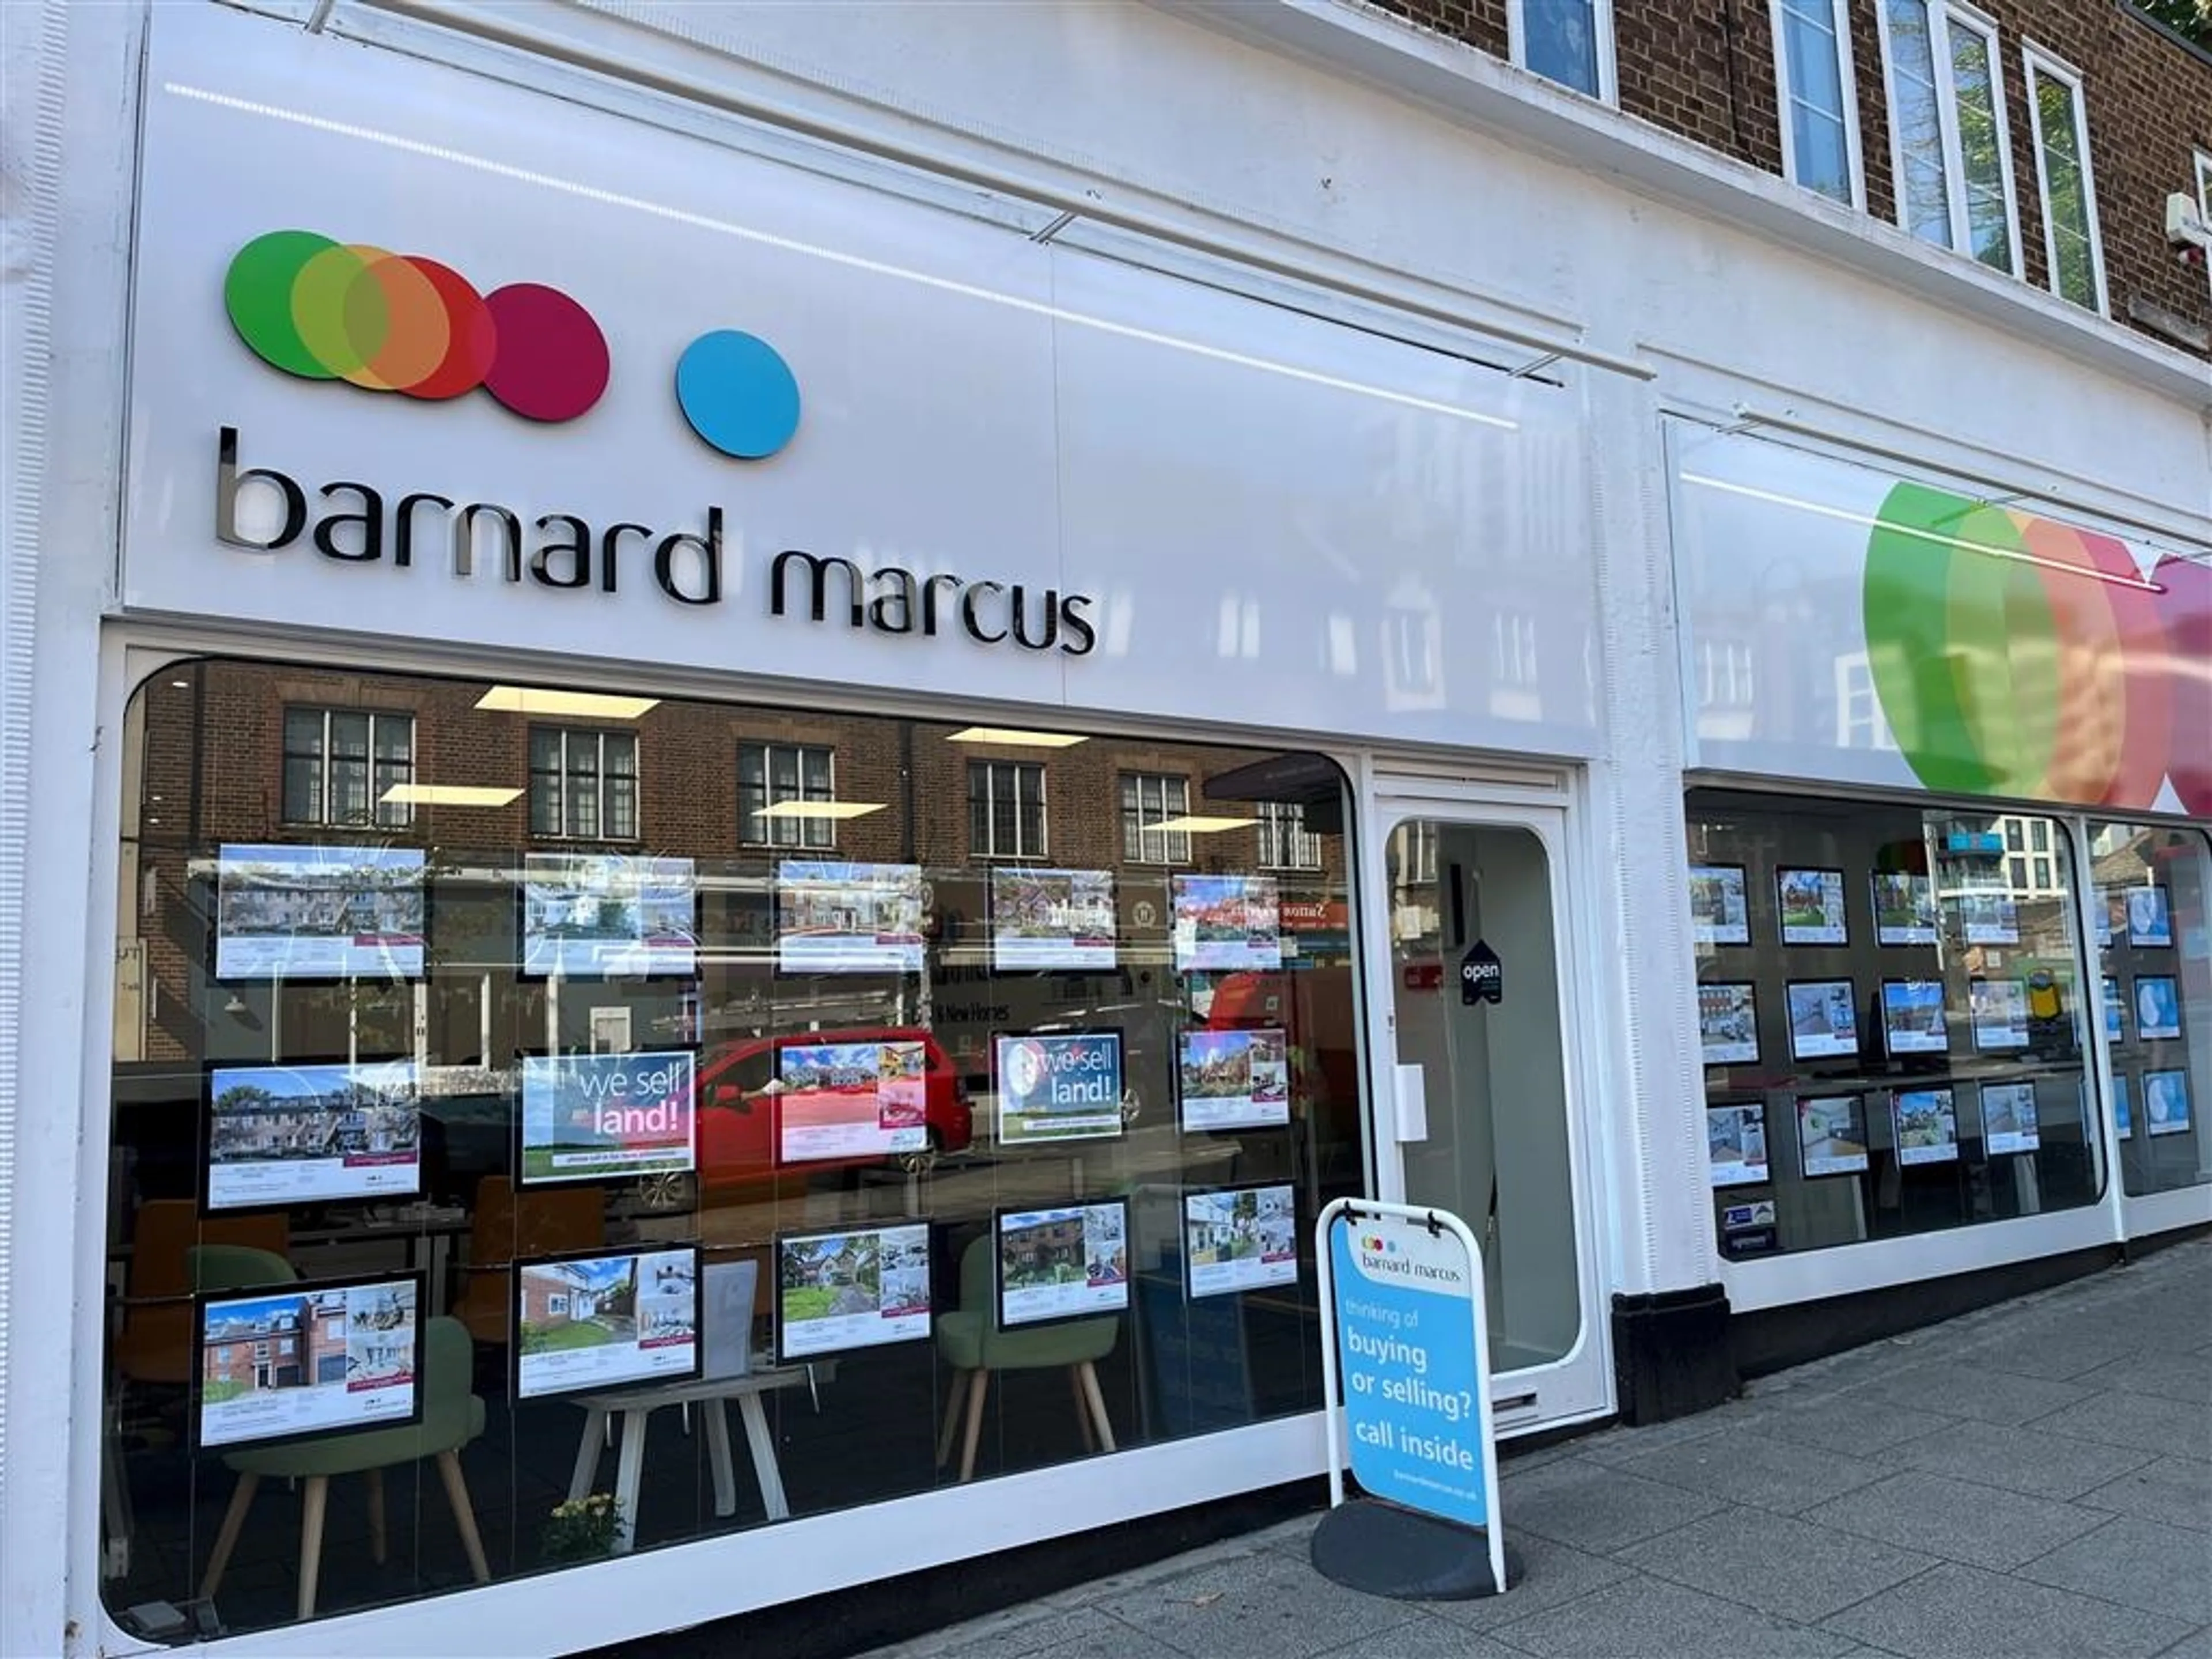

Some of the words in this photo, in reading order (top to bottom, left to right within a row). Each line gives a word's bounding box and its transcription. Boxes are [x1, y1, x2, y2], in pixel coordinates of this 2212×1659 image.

[214, 425, 725, 606] barnard
[770, 548, 1097, 657] marcus
[1463, 964, 1499, 983] open
[1039, 1050, 1075, 1074] we
[1079, 1041, 1112, 1071] sell
[579, 1071, 628, 1097] we
[635, 1061, 680, 1096] sell
[1051, 1074, 1111, 1105] land!
[593, 1099, 679, 1135] land!
[1362, 1253, 1410, 1275] barnard
[1414, 1263, 1461, 1281] marcus
[1345, 1298, 1401, 1330] thinking
[1404, 1309, 1419, 1328] of
[1347, 1325, 1427, 1374] buying
[1351, 1372, 1376, 1394] or
[1382, 1376, 1472, 1422] selling?
[1355, 1419, 1394, 1449] call
[1399, 1426, 1475, 1471] inside
